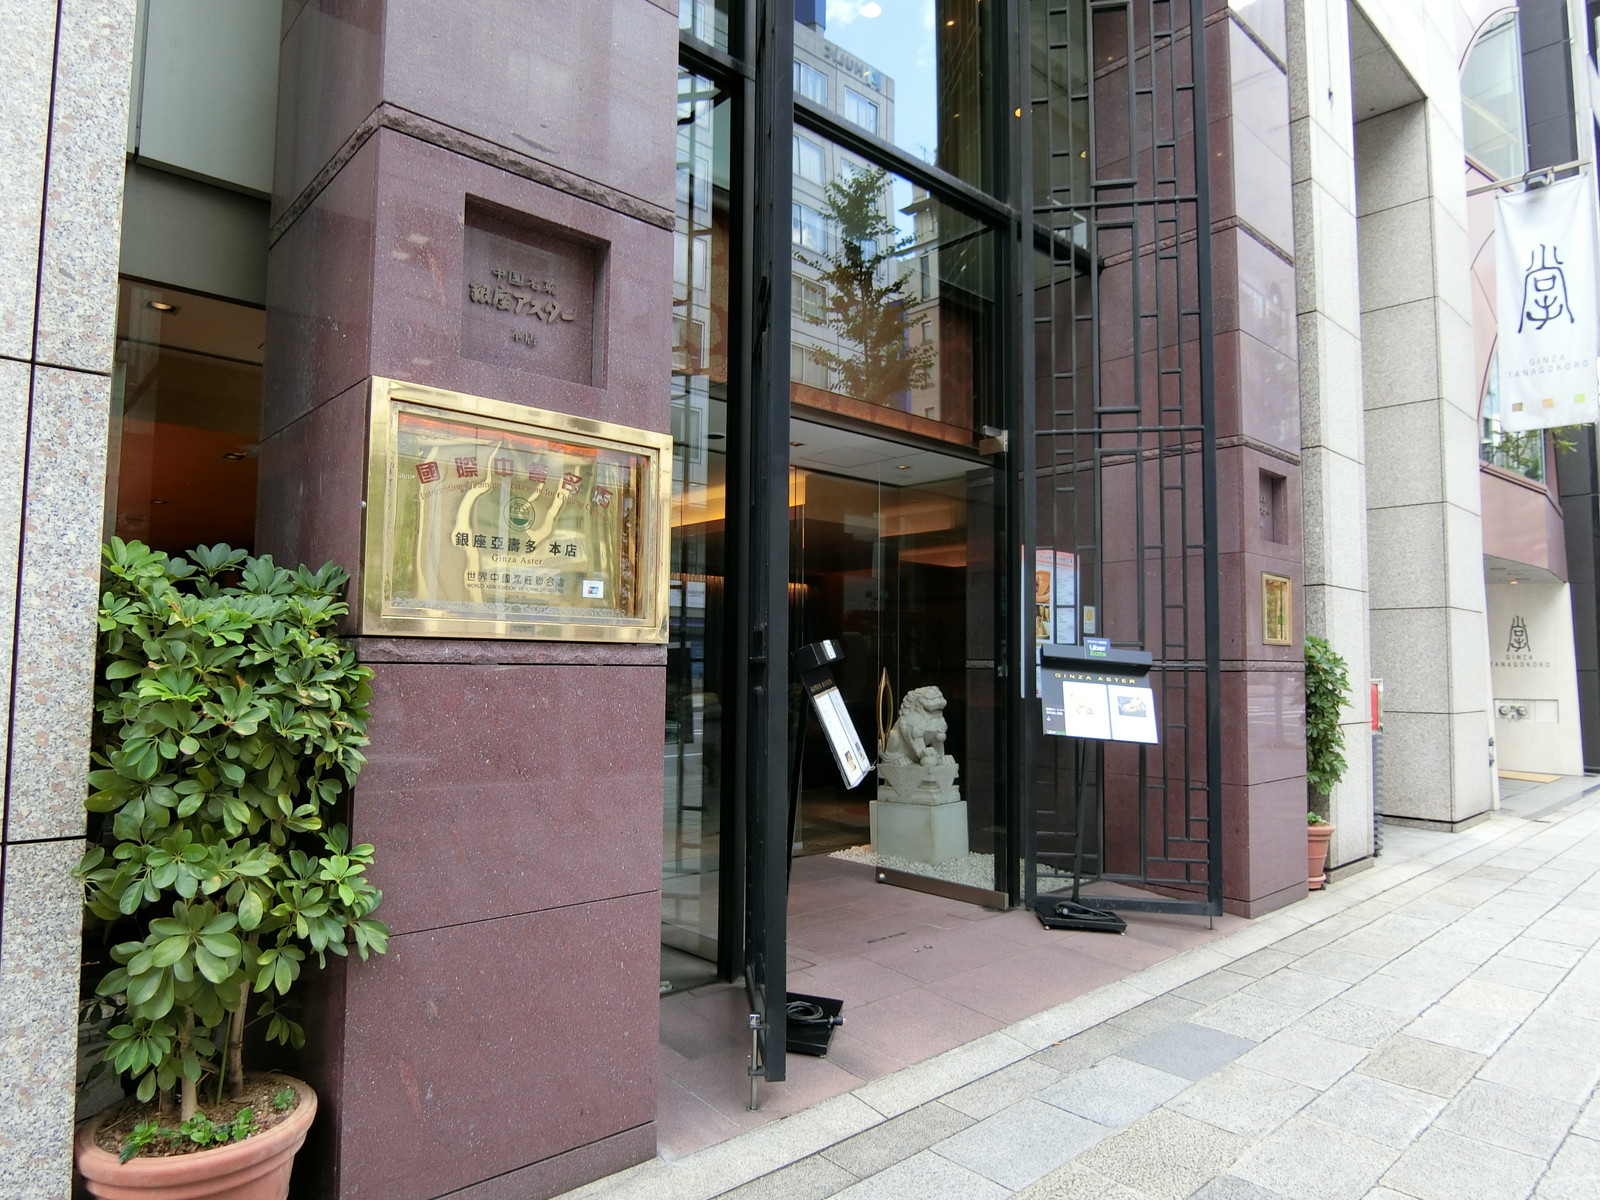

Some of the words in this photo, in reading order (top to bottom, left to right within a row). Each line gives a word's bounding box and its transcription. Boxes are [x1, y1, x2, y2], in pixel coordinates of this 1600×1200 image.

[468, 282, 575, 324] 銀座アスター
[1529, 354, 1565, 366] GINZA
[549, 541, 578, 558] 本店
[491, 554, 517, 563] Ginza
[520, 557, 543, 566] Aster
[1054, 672, 1092, 681] GINZA
[1097, 676, 1136, 685] ASTER
